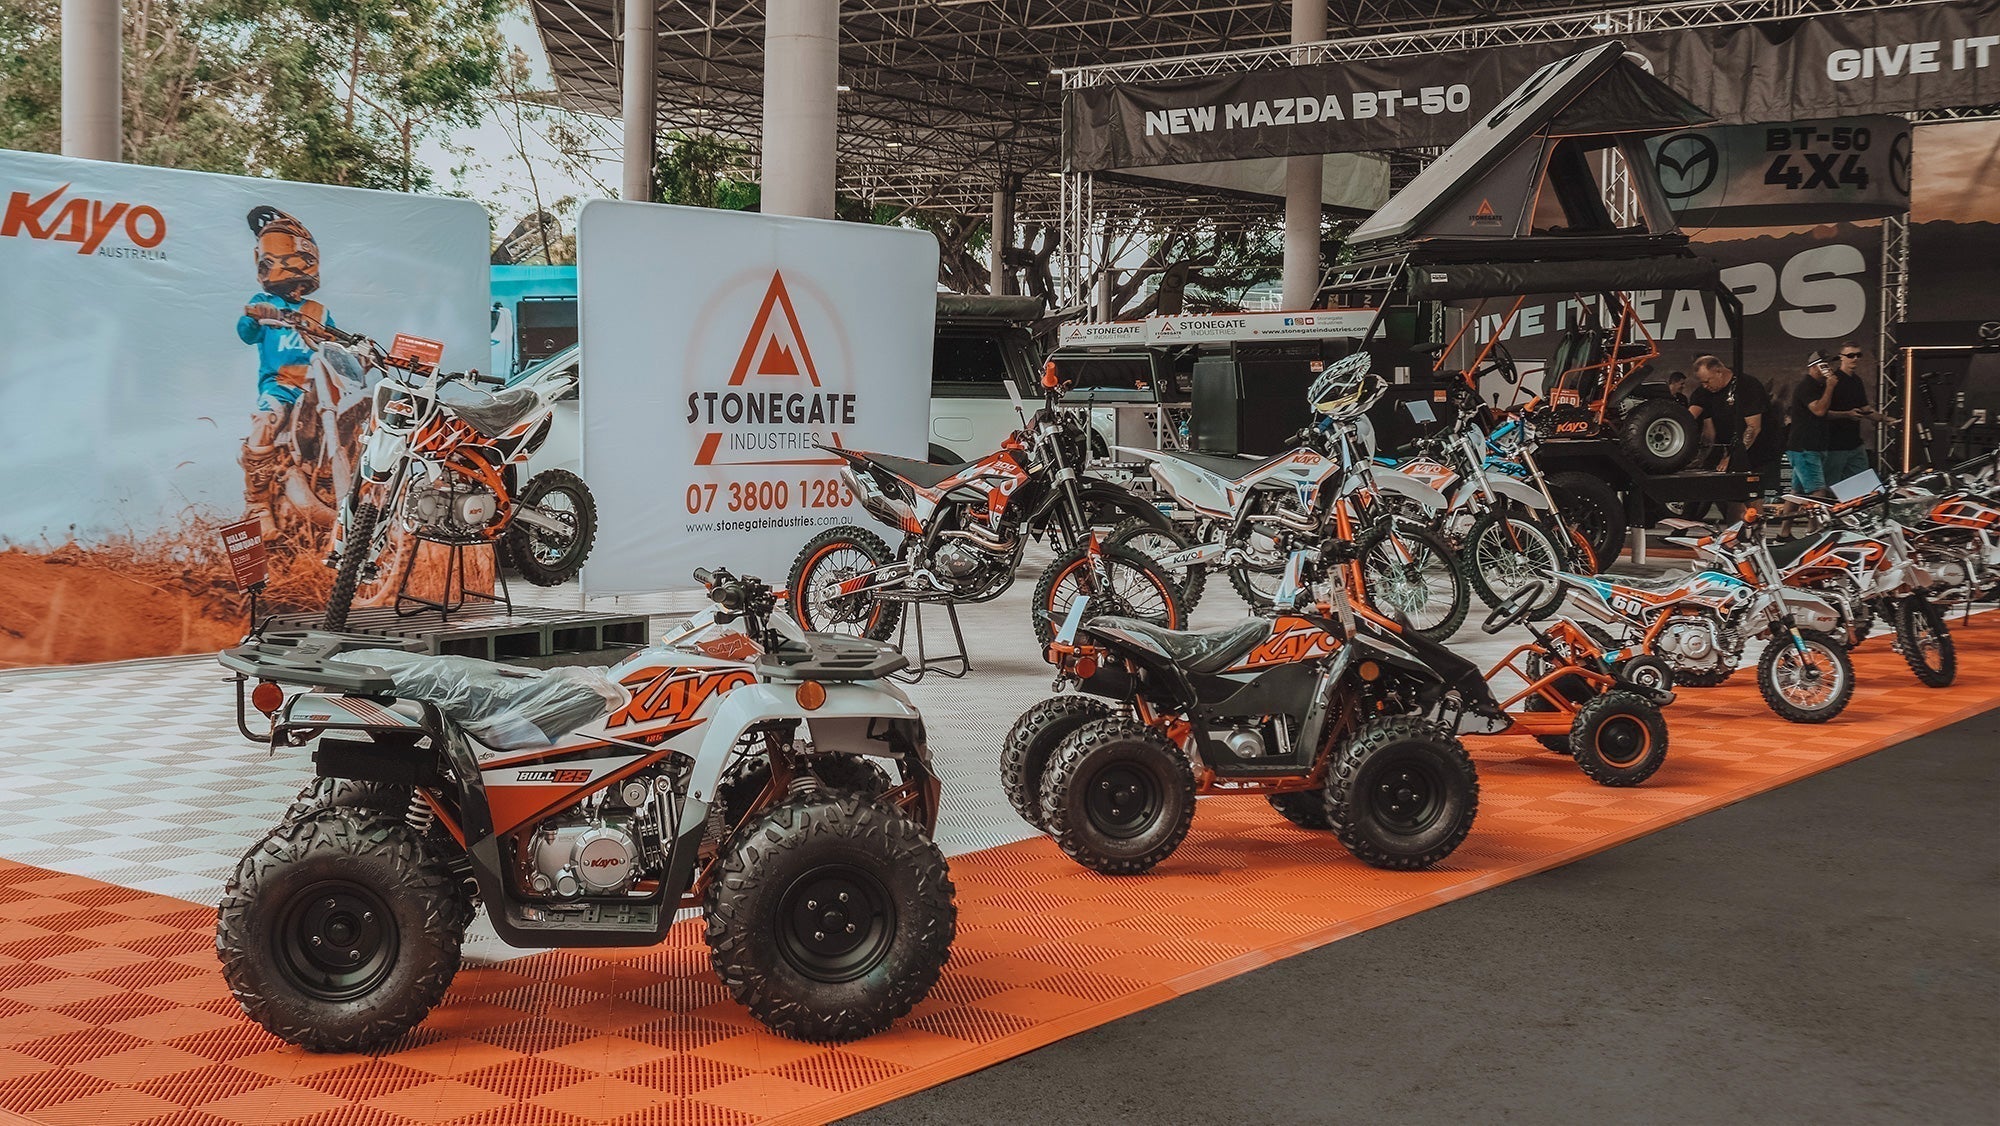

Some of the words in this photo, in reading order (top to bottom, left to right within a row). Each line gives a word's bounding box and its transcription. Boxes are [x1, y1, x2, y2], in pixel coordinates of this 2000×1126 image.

[1827, 41, 1940, 81] GIVE
[1953, 35, 2000, 70] IT
[1145, 105, 1217, 136] NEW
[1225, 95, 1345, 129] MAZDA
[1352, 84, 1471, 120] BT-50
[1766, 127, 1871, 151] BT-50
[1764, 153, 1870, 189] 4X4
[1, 182, 166, 254] KAYO
[98, 247, 168, 262] AUSTRALIA
[1600, 244, 1867, 339] EAPS
[1086, 326, 1141, 336] STONEGATE
[1180, 319, 1247, 331] STONEGATE
[1191, 328, 1237, 337] INDUSTRIES
[1475, 305, 1545, 345] IVE
[687, 391, 856, 424] STONEGATE
[1556, 421, 1589, 433] KAYO
[730, 432, 820, 450] INDUSTRIES
[1291, 454, 1322, 465] KAYO
[1413, 463, 1442, 474] KAYO
[686, 483, 718, 515] 07
[727, 480, 789, 512] 3800
[799, 479, 854, 508] 1283
[686, 515, 854, 533] www.stonegateindustries.com.au
[1173, 551, 1198, 564] KAYO
[875, 569, 898, 582] KAYO
[1611, 594, 1643, 617] 60
[1247, 621, 1342, 665] KAYO
[604, 668, 758, 731] KAYO
[590, 858, 619, 868] KAYO
